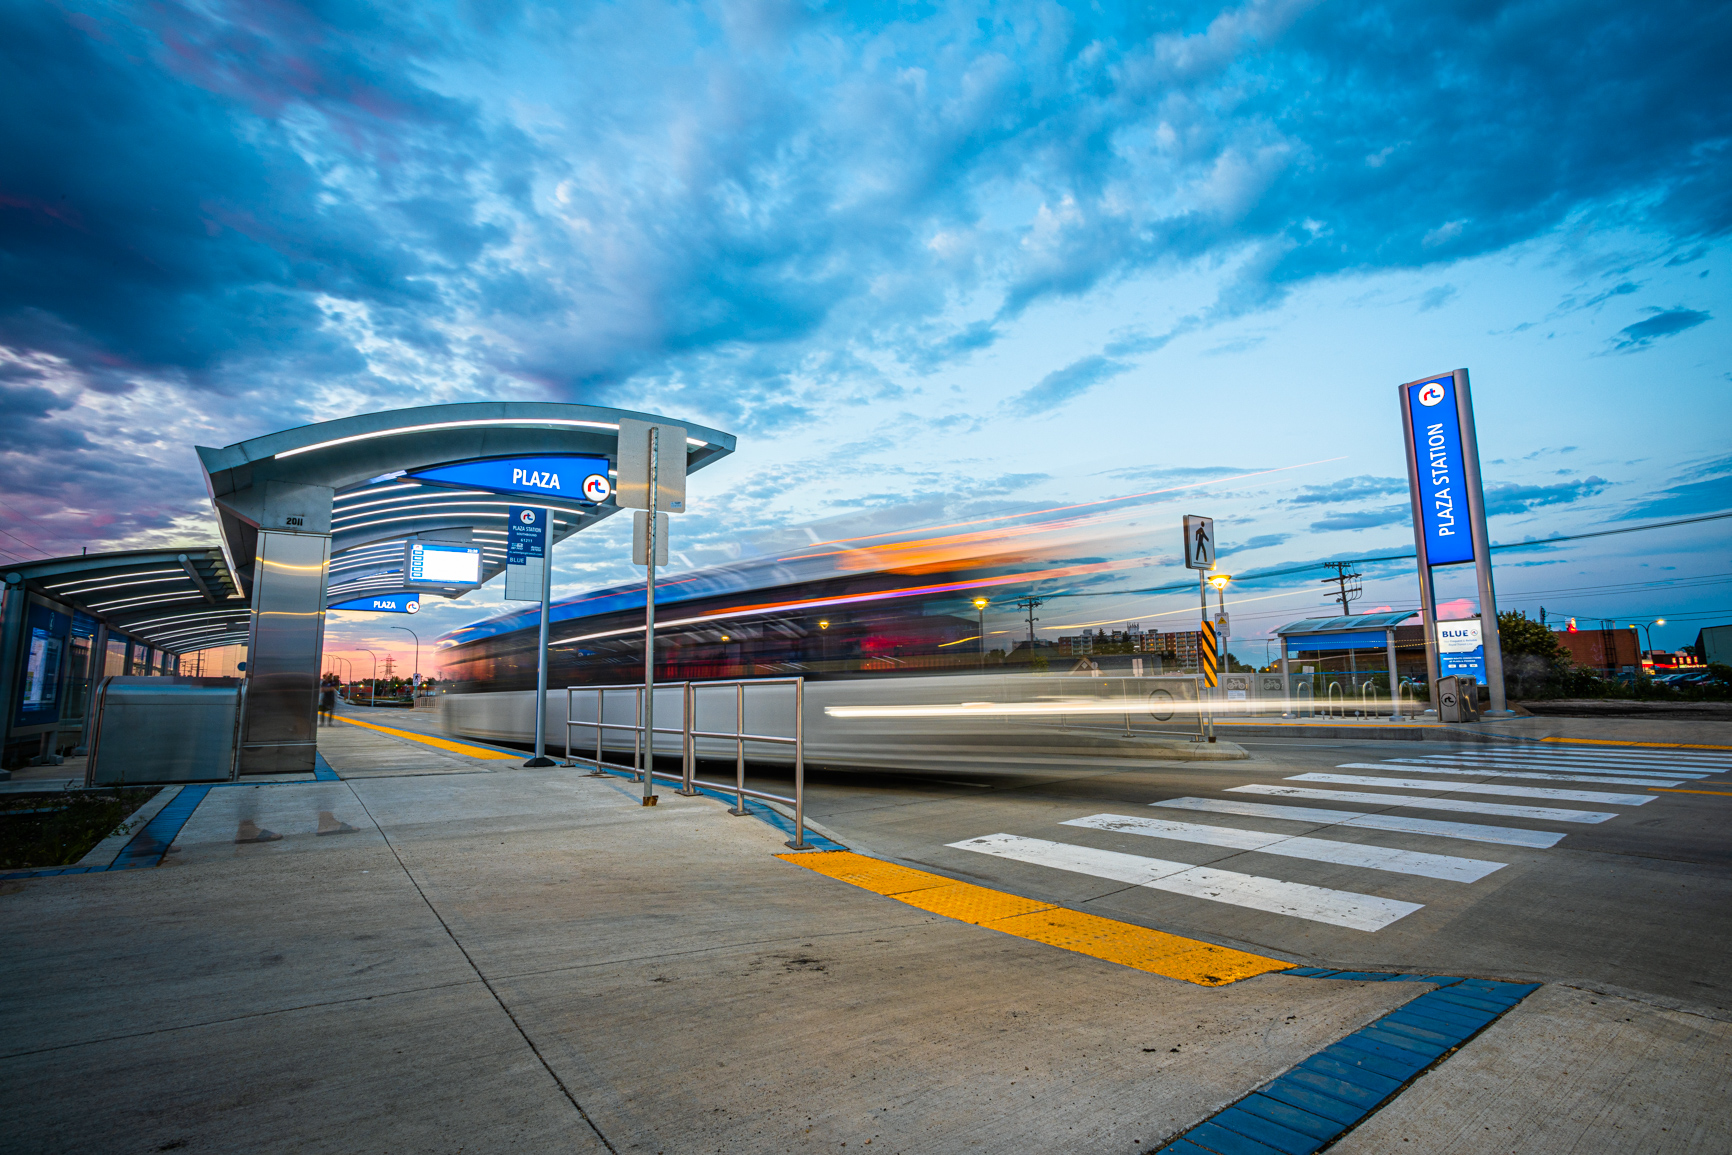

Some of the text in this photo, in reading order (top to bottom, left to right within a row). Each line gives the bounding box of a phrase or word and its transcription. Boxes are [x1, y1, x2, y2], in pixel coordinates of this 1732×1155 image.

[512, 468, 561, 490] PLAZA
[1427, 422, 1455, 537] PLAZA STATION
[286, 517, 304, 526] 2011
[373, 600, 397, 609] PLAZA
[1442, 630, 1469, 638] BLUE
